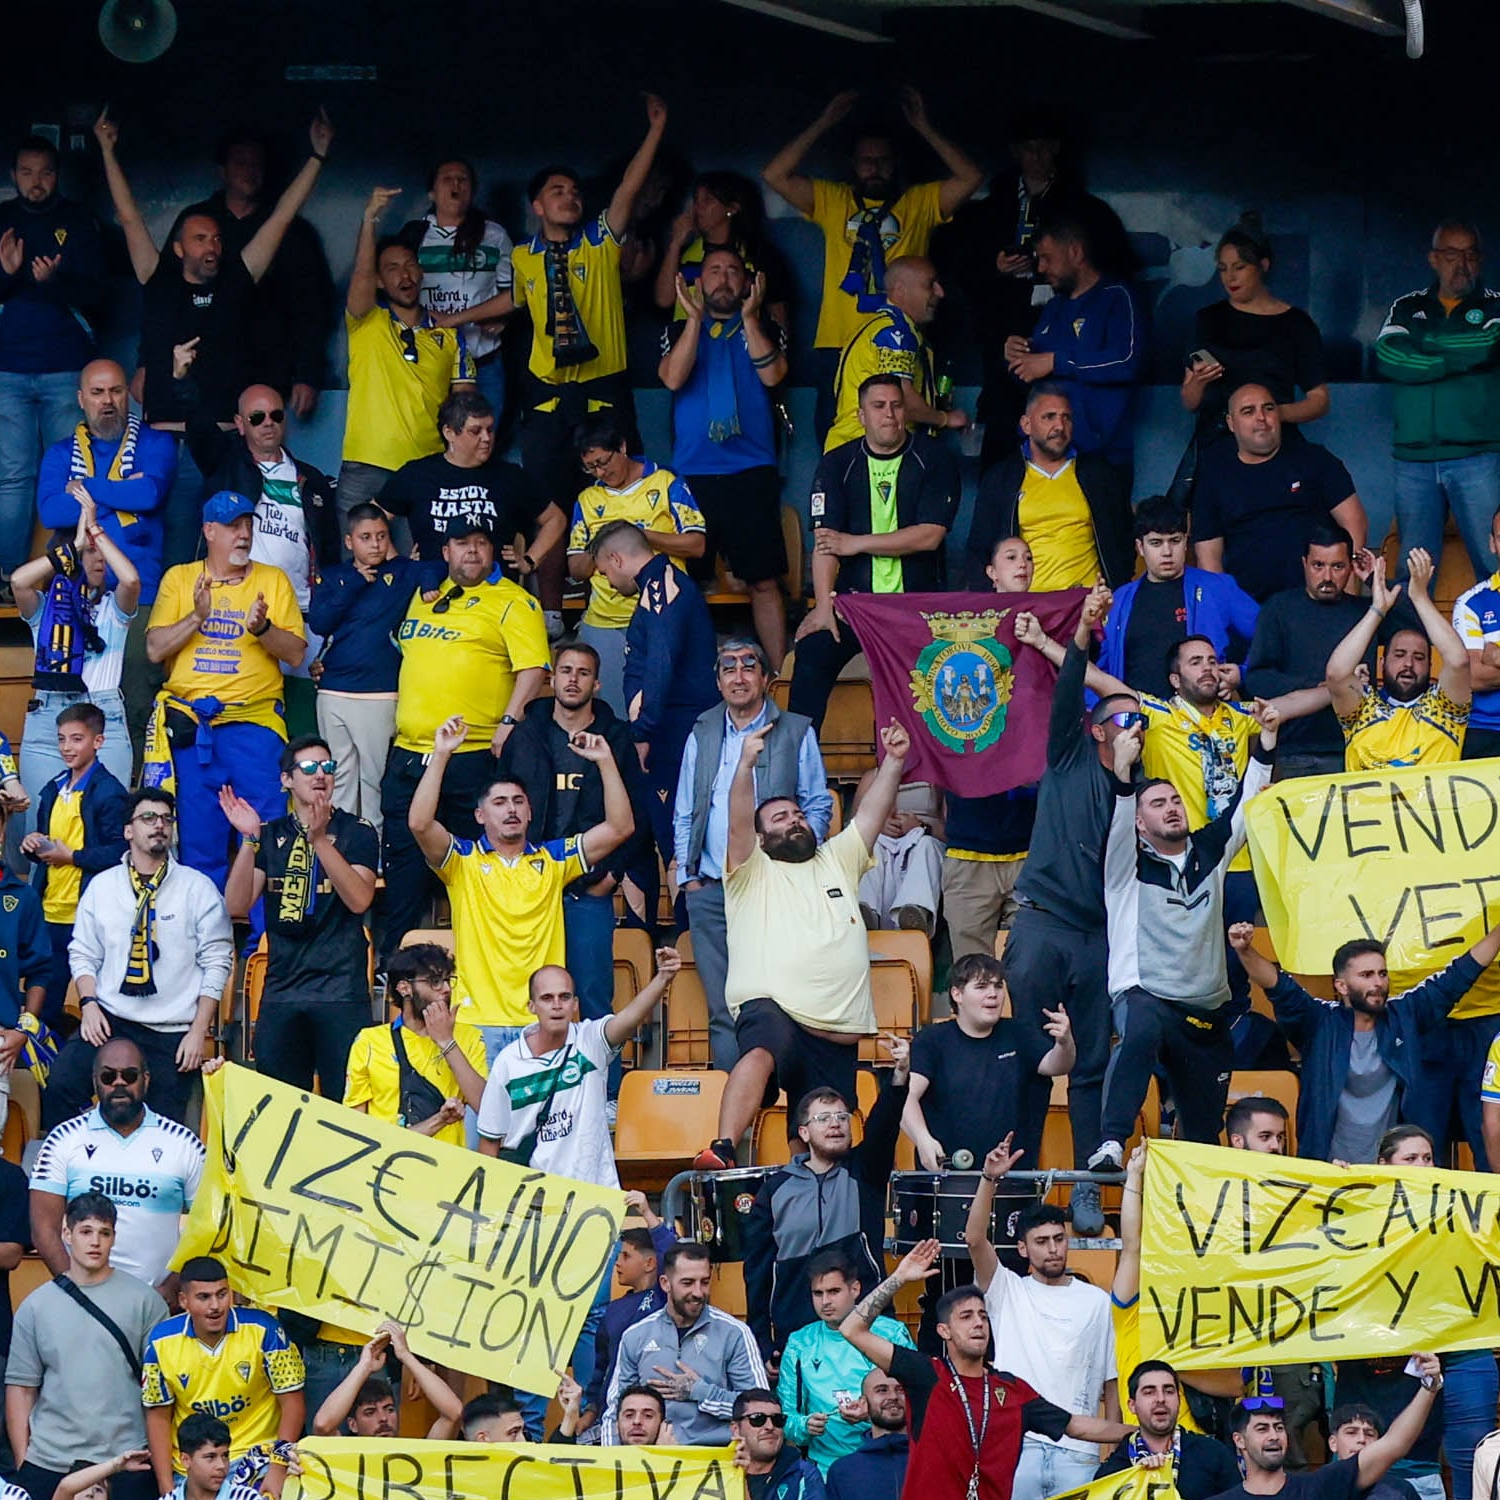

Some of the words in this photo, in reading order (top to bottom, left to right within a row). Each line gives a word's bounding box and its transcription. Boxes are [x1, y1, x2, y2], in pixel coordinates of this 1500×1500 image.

[438, 485, 489, 500] ESTOY
[431, 500, 498, 518] HASTA
[1147, 1282, 1347, 1352] VENDE
[1384, 1269, 1420, 1332] Y
